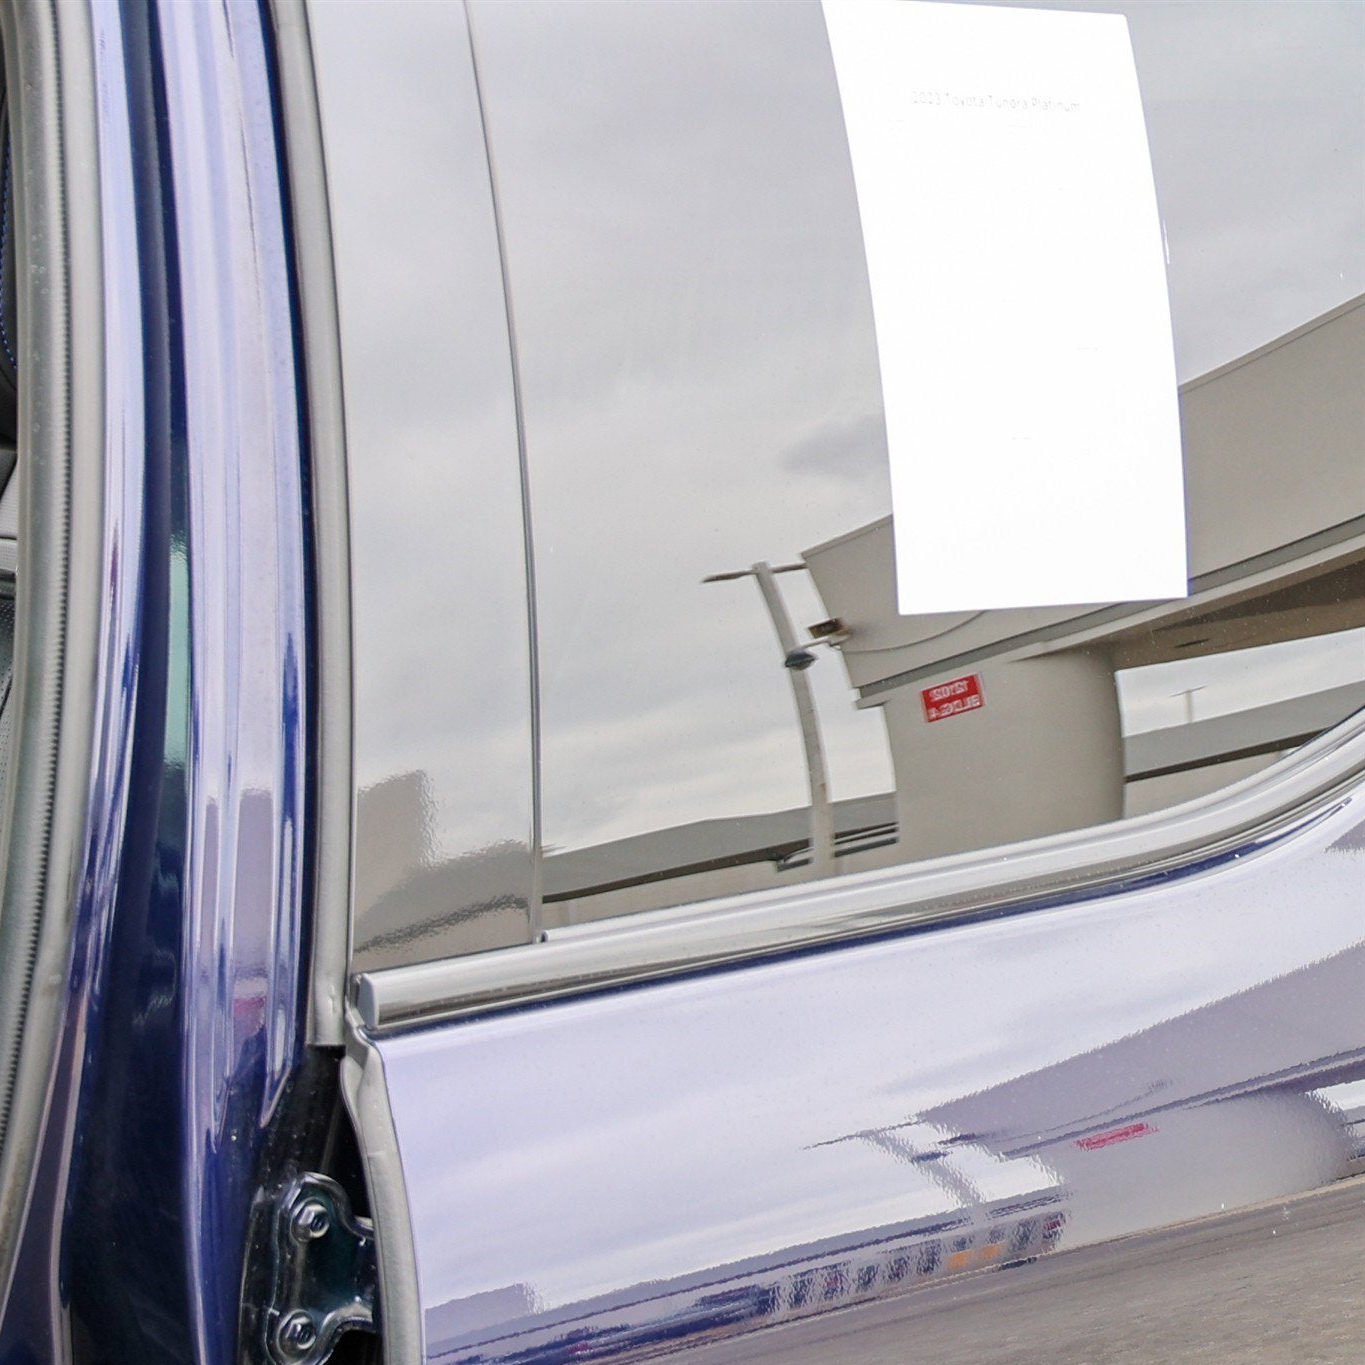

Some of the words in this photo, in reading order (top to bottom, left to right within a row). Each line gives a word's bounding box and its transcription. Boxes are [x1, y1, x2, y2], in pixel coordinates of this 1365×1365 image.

[945, 91, 985, 109] Toyota
[988, 93, 1028, 110] Tundra
[1031, 96, 1081, 113] Platinum
